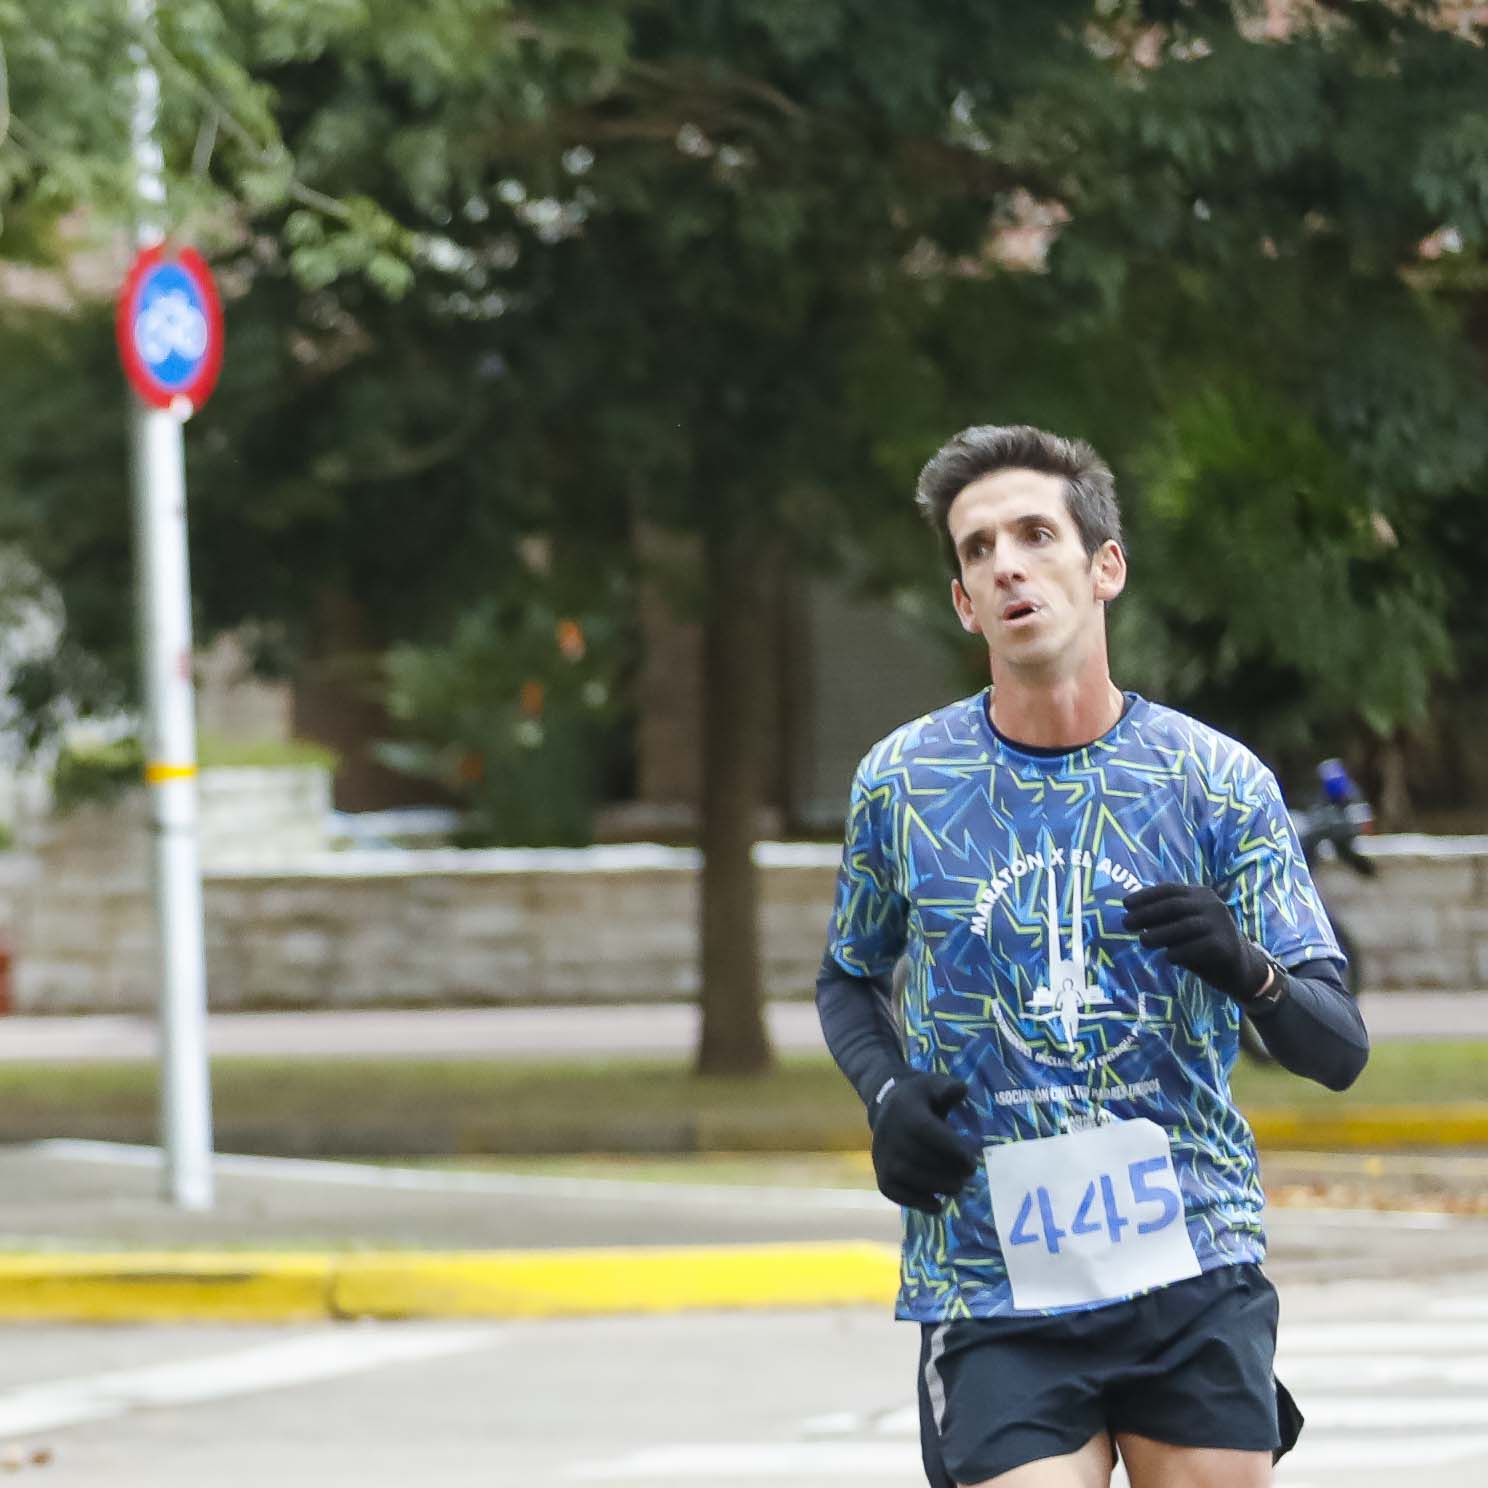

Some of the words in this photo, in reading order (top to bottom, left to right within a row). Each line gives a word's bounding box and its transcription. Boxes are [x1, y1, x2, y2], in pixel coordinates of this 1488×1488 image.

[1051, 848, 1065, 866] X
[1095, 857, 1143, 894] AUTI
[1009, 1155, 1180, 1254] 445
